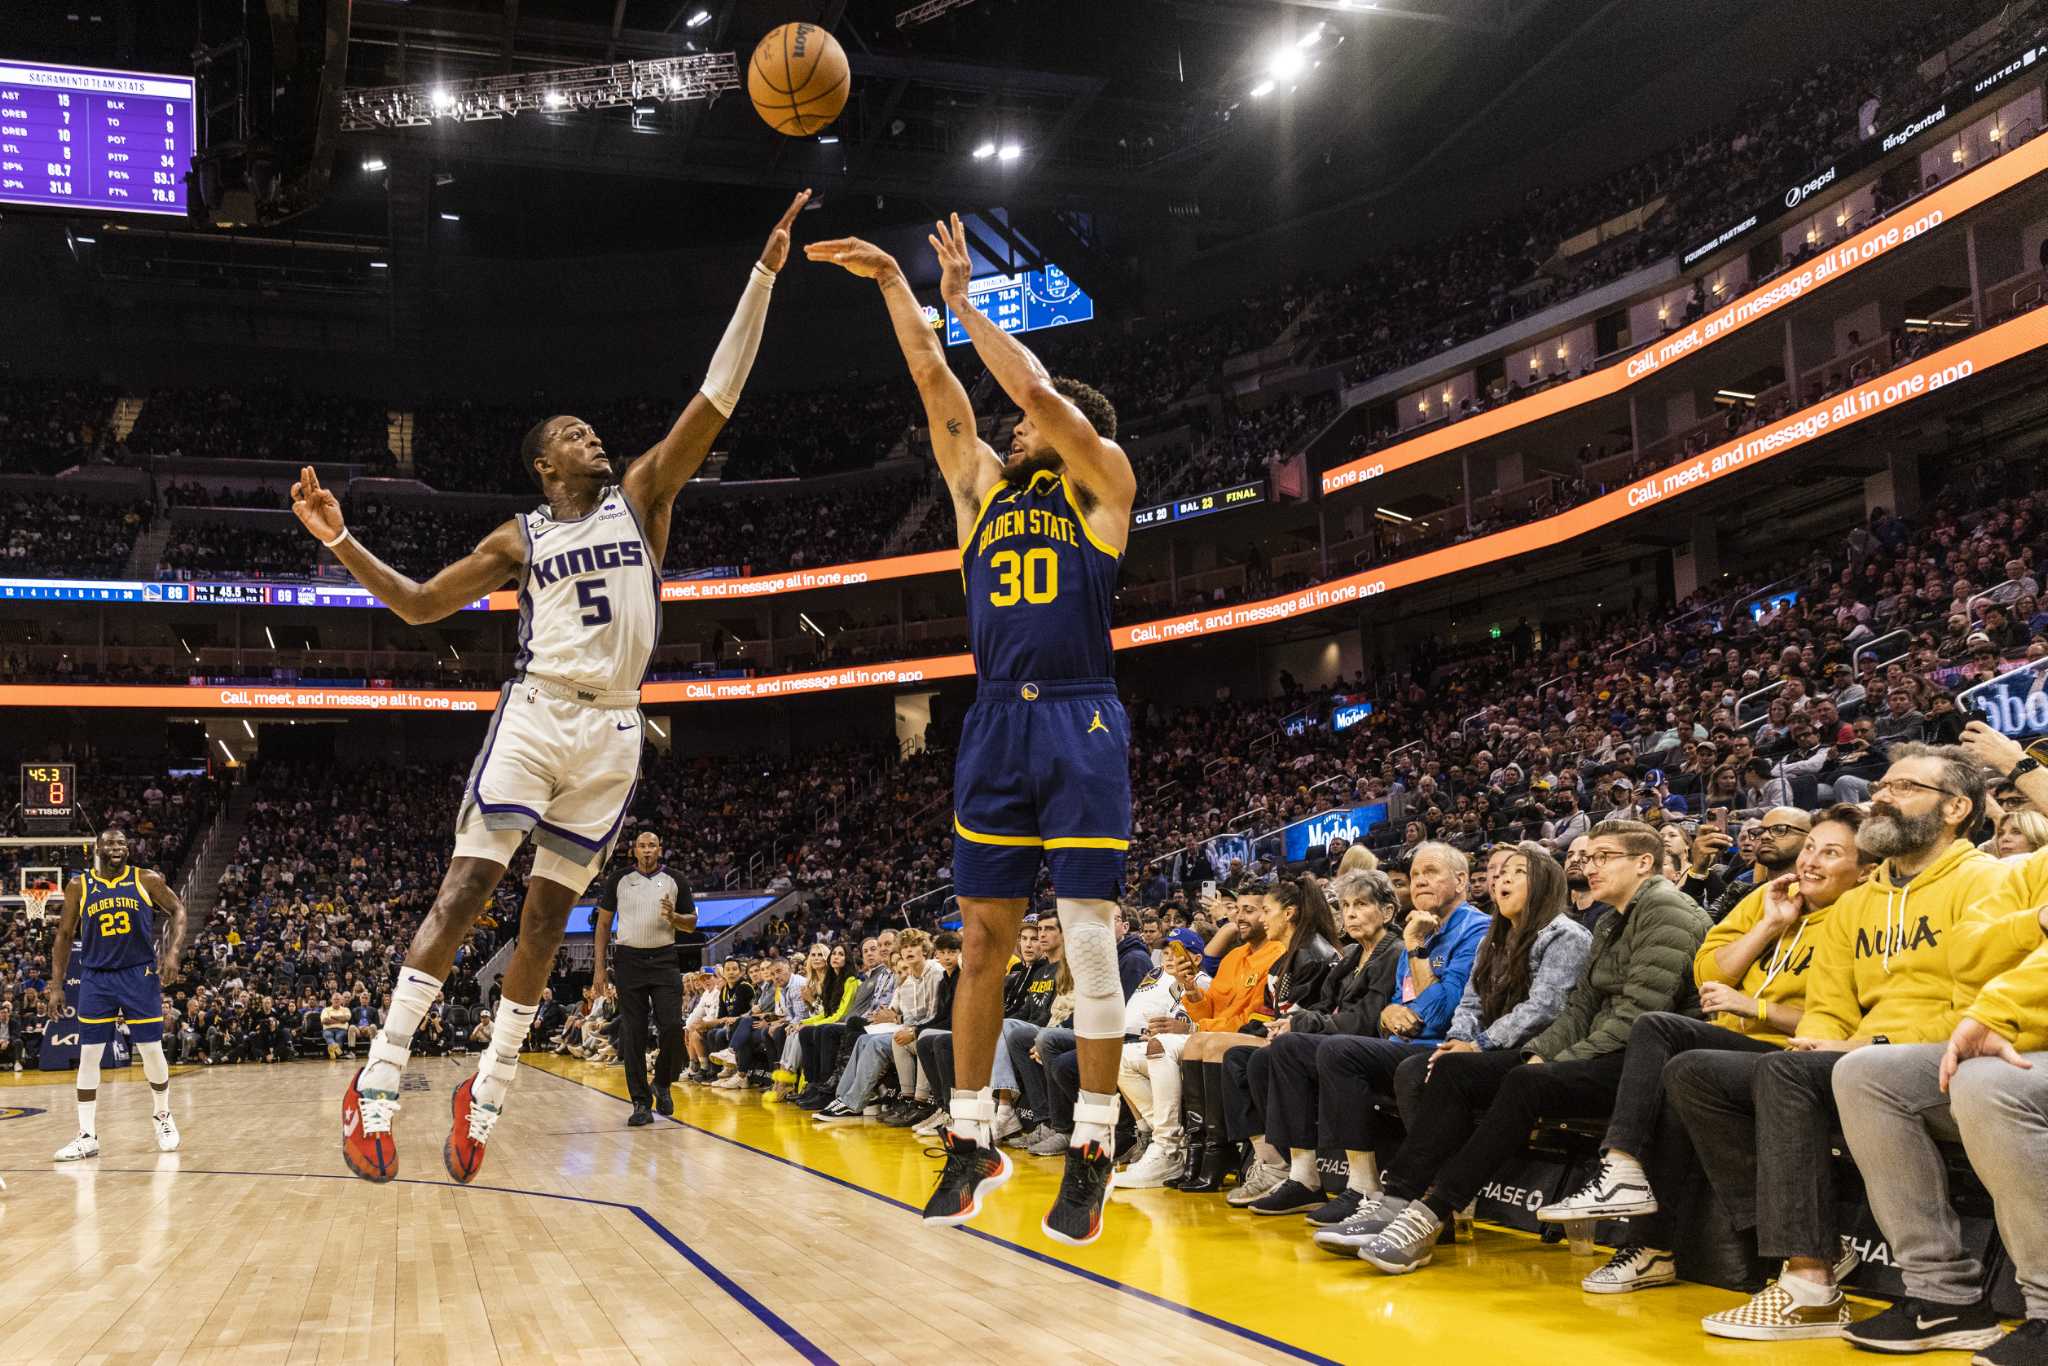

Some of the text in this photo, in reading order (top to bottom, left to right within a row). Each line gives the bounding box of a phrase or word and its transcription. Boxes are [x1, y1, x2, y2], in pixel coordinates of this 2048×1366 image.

[29, 72, 145, 92] SACRAMENTO TEAM STATS
[1975, 60, 2022, 91] UNITED
[107, 100, 125, 110] BLK
[1882, 104, 1946, 152] RingCentral
[1802, 166, 1835, 199] pepsi
[1684, 215, 1758, 264] FOUNDING PARTNERS
[1627, 354, 1658, 378] Call,
[1660, 332, 1704, 362] meet,
[1705, 312, 1734, 336] and
[1737, 271, 1811, 321] message
[1816, 255, 1838, 280] all
[1840, 246, 1857, 267] in
[1862, 227, 1898, 257] one
[1628, 482, 1661, 506] Call,
[1663, 462, 1709, 494] meet,
[1712, 445, 1747, 472] and
[1747, 409, 1829, 456] message
[1832, 396, 1857, 423] all
[1860, 390, 1879, 412] in
[1883, 373, 1923, 404] one
[1322, 479, 1330, 491] n
[1332, 470, 1356, 488] one
[1180, 488, 1256, 513] BAL 23 FINAL
[598, 510, 627, 521] dialpad
[1029, 508, 1079, 548] STATE
[1135, 511, 1153, 524] CLE
[532, 540, 643, 590] KINGS
[990, 547, 1058, 607] 30
[662, 584, 699, 599] meet,
[702, 581, 726, 596] and
[729, 579, 784, 594] message
[787, 575, 801, 588] all
[804, 573, 814, 586] in
[818, 573, 841, 585] one
[575, 578, 612, 627] 5
[1131, 628, 1161, 643] Call,
[1163, 618, 1203, 637] meet,
[1206, 611, 1232, 630] and
[1236, 600, 1296, 624] message
[1299, 594, 1314, 609] all
[1317, 591, 1328, 604] in
[1331, 583, 1356, 603] one
[687, 684, 715, 698] Call,
[718, 681, 756, 696] meet,
[757, 679, 780, 694] and
[783, 675, 838, 692] message
[840, 671, 854, 685] all
[857, 670, 869, 682] in
[872, 668, 896, 682] one
[221, 691, 252, 706] Call,
[255, 692, 295, 706] meet,
[298, 691, 323, 704] and
[327, 693, 387, 707] message
[390, 692, 406, 706] all
[409, 693, 421, 706] in
[424, 697, 448, 707] one
[29, 768, 60, 782] 45.3
[49, 782, 64, 804] 8
[38, 808, 72, 816] TISSOT
[87, 897, 140, 917] GOLDEN STATE
[98, 911, 131, 937] 23
[1855, 915, 1942, 960] NUNA
[1315, 1158, 1350, 1176] CHAS
[1478, 1181, 1527, 1207] HASE
